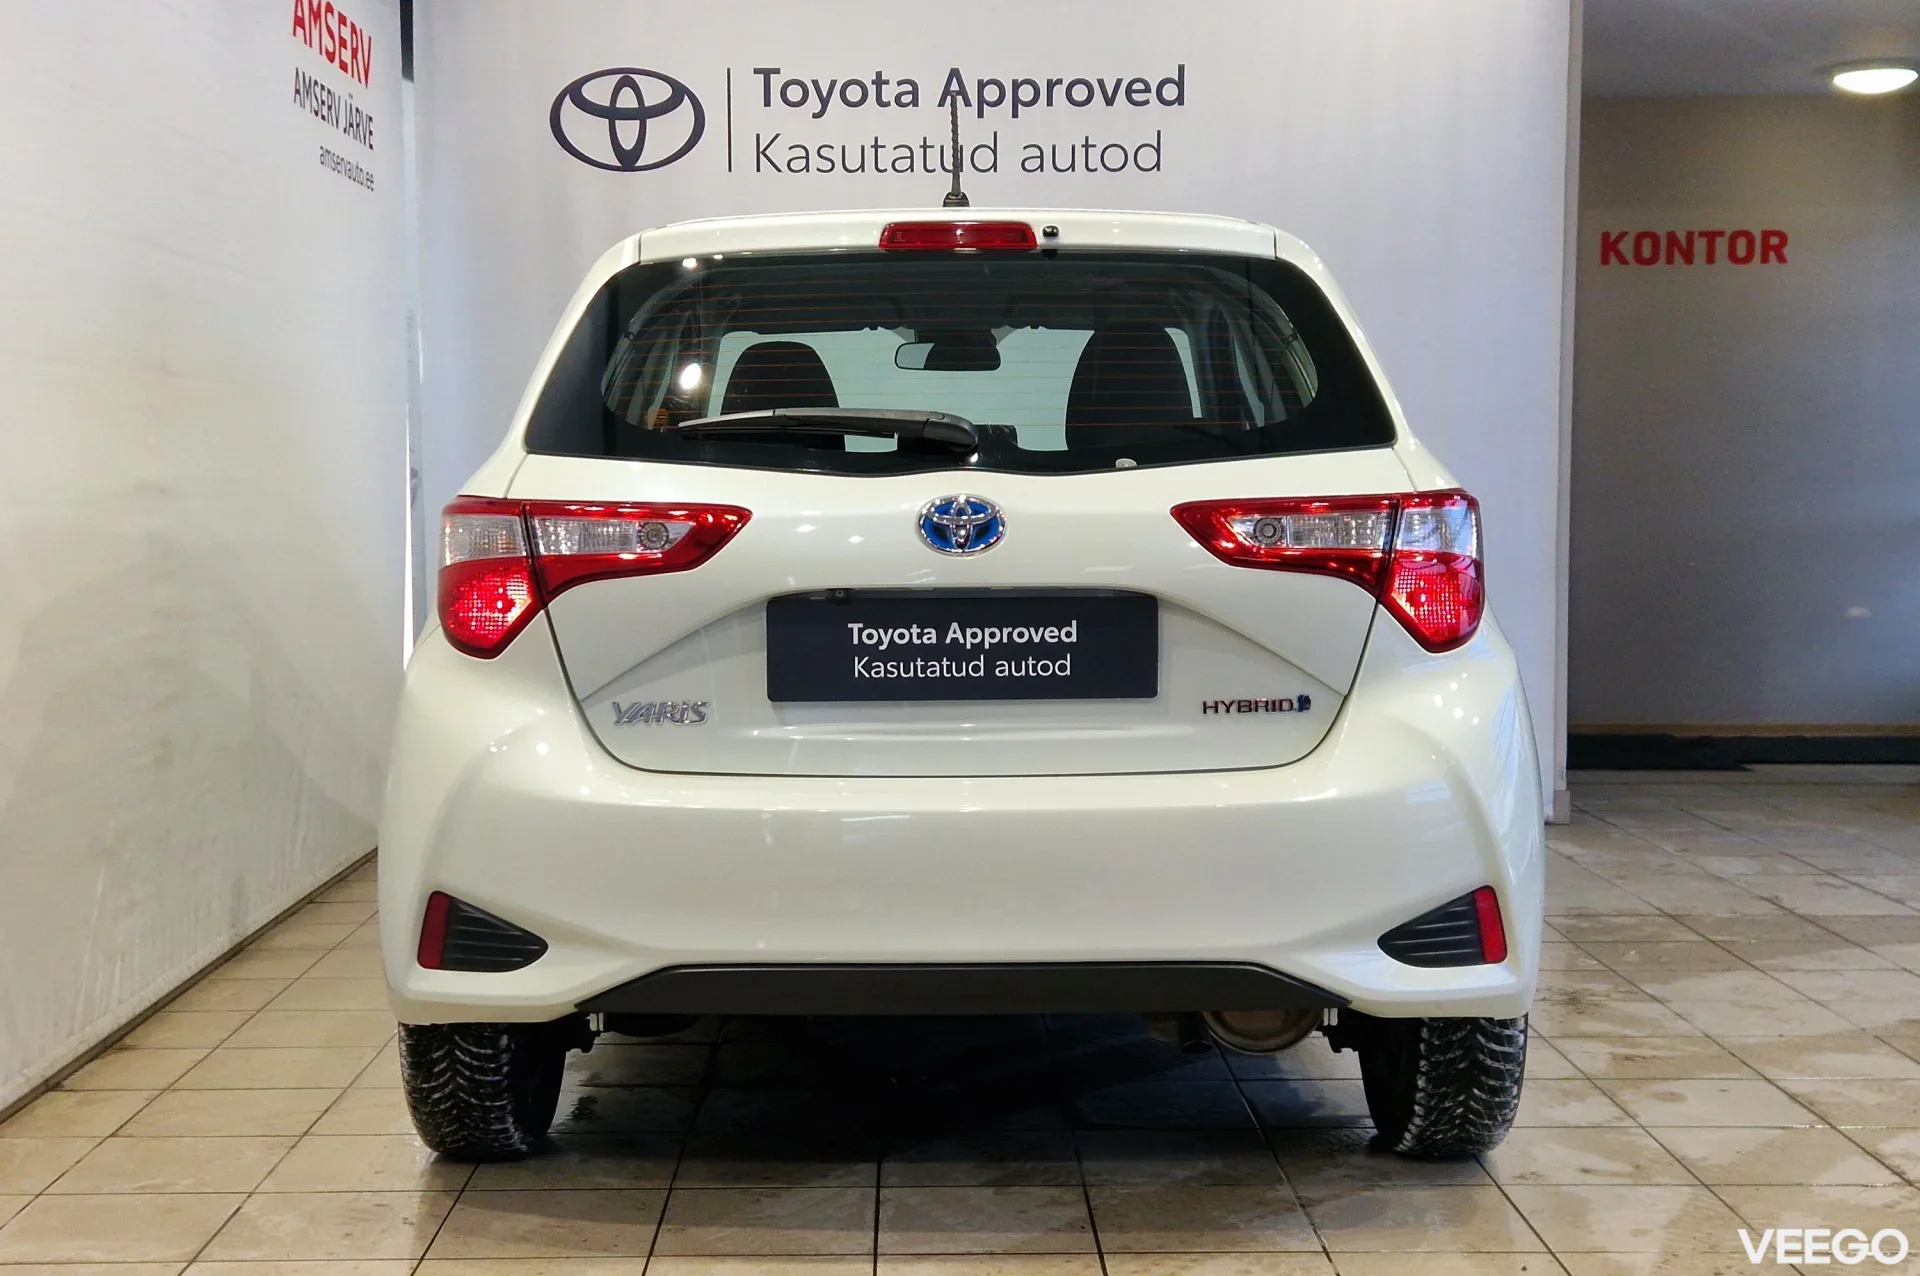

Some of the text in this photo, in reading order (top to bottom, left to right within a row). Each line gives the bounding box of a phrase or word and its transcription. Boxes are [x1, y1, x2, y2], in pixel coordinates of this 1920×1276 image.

[293, 0, 371, 89] AMSERV
[293, 67, 374, 150] AMSERV JÄRVE
[753, 64, 1186, 119] Toyota Approved
[319, 145, 375, 192] amservauto.ee
[755, 129, 1162, 174] Kasutatud autod
[1600, 229, 1789, 266] KONTOR
[847, 619, 1078, 650] Toyota Approved
[853, 652, 1072, 678] Kasutatud autod
[1202, 698, 1294, 715] HYBRID
